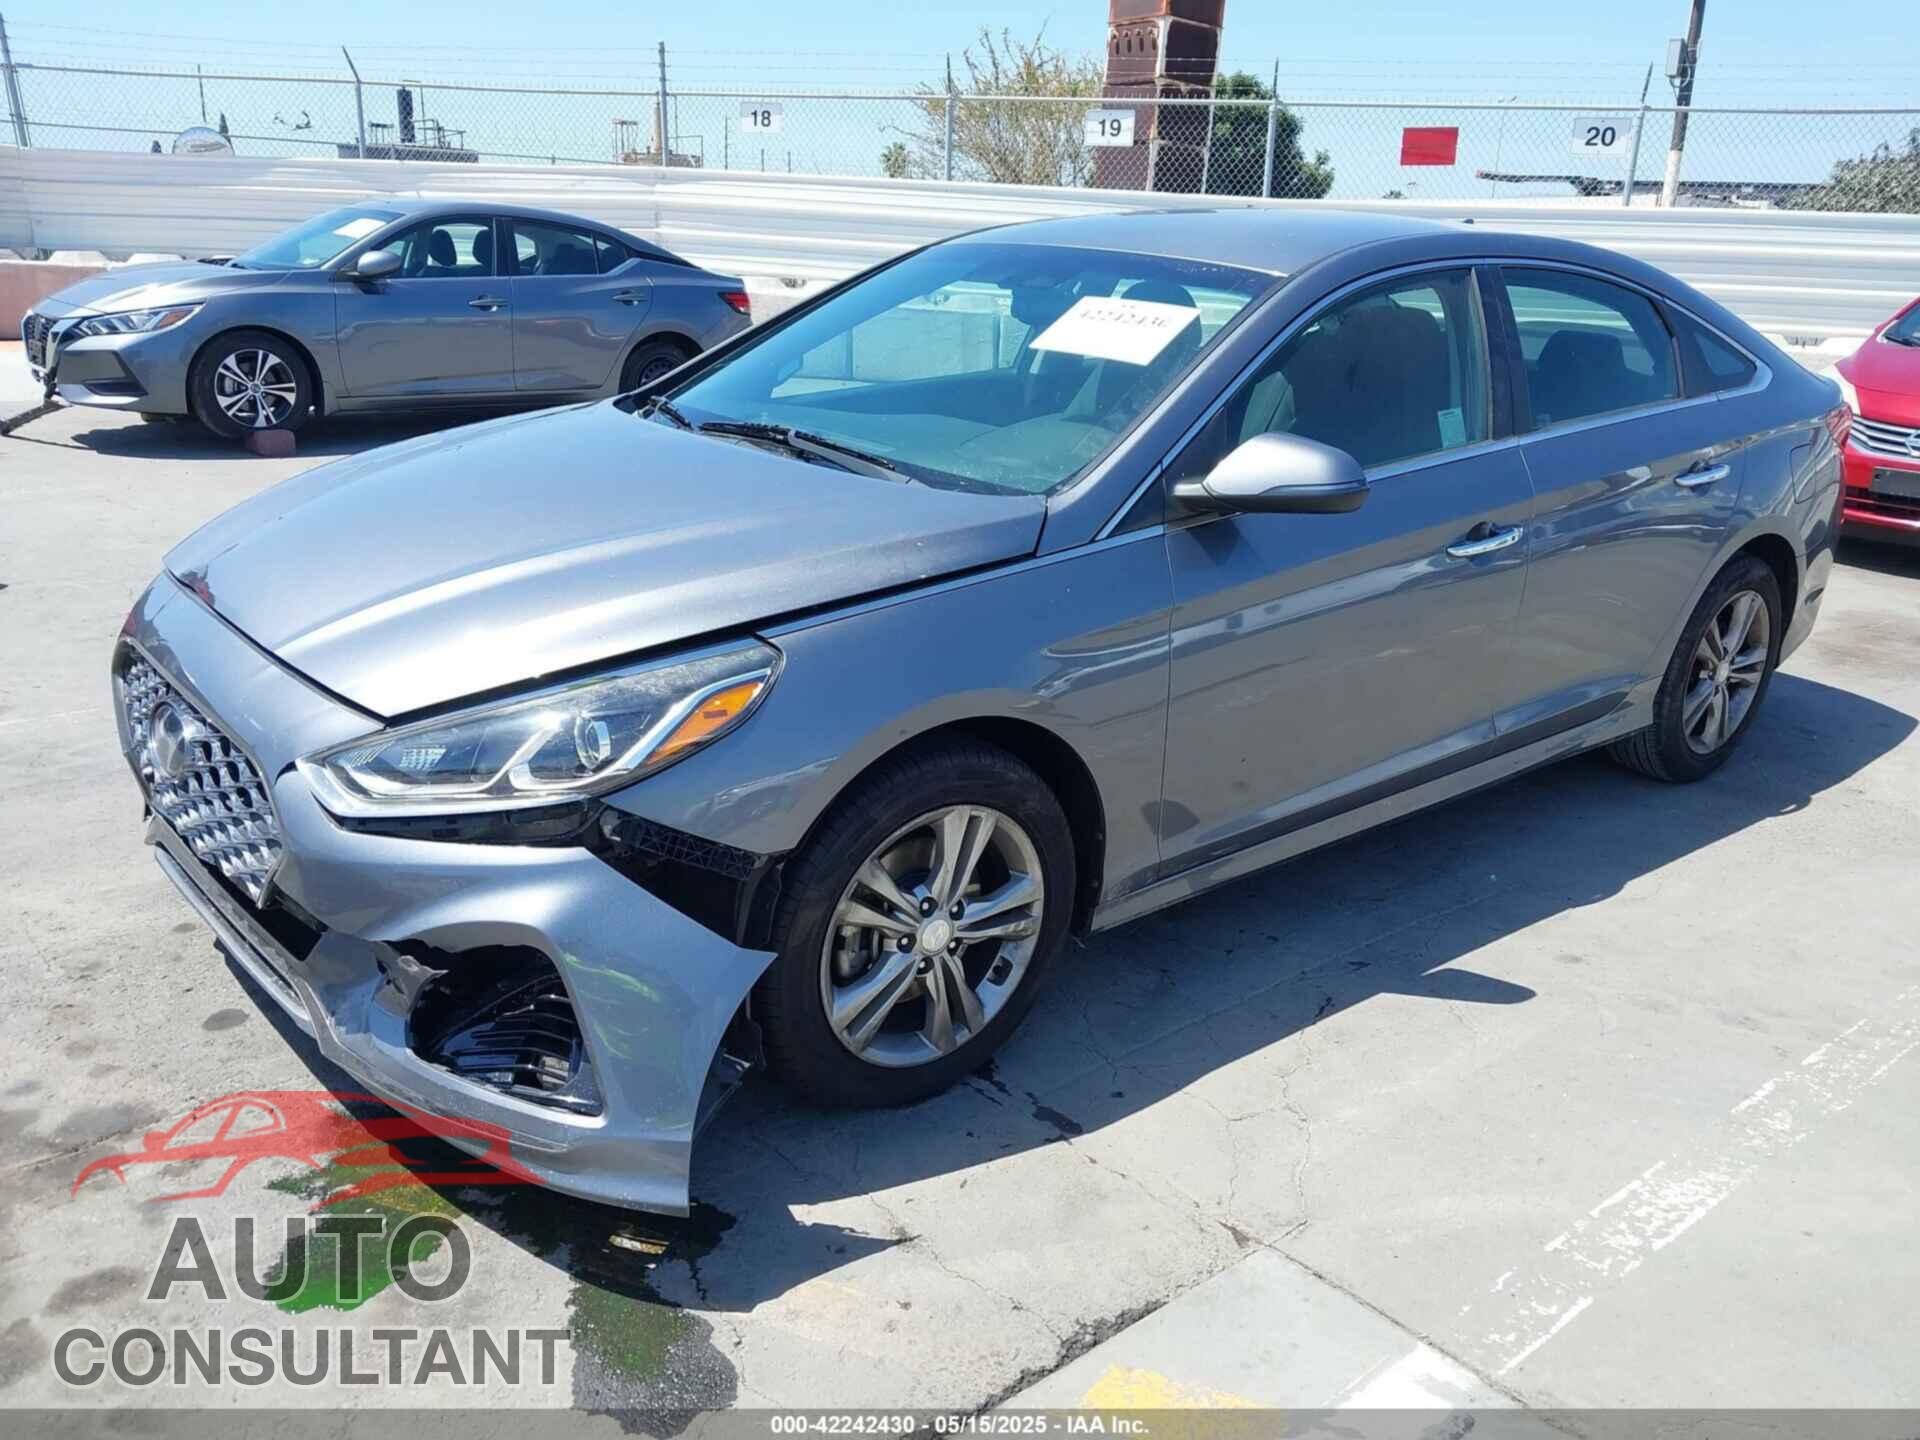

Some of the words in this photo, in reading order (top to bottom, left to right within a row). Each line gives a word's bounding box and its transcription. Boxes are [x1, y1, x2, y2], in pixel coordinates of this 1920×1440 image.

[751, 110, 771, 127] 18
[1099, 119, 1121, 136] 19
[1585, 126, 1616, 147] 20
